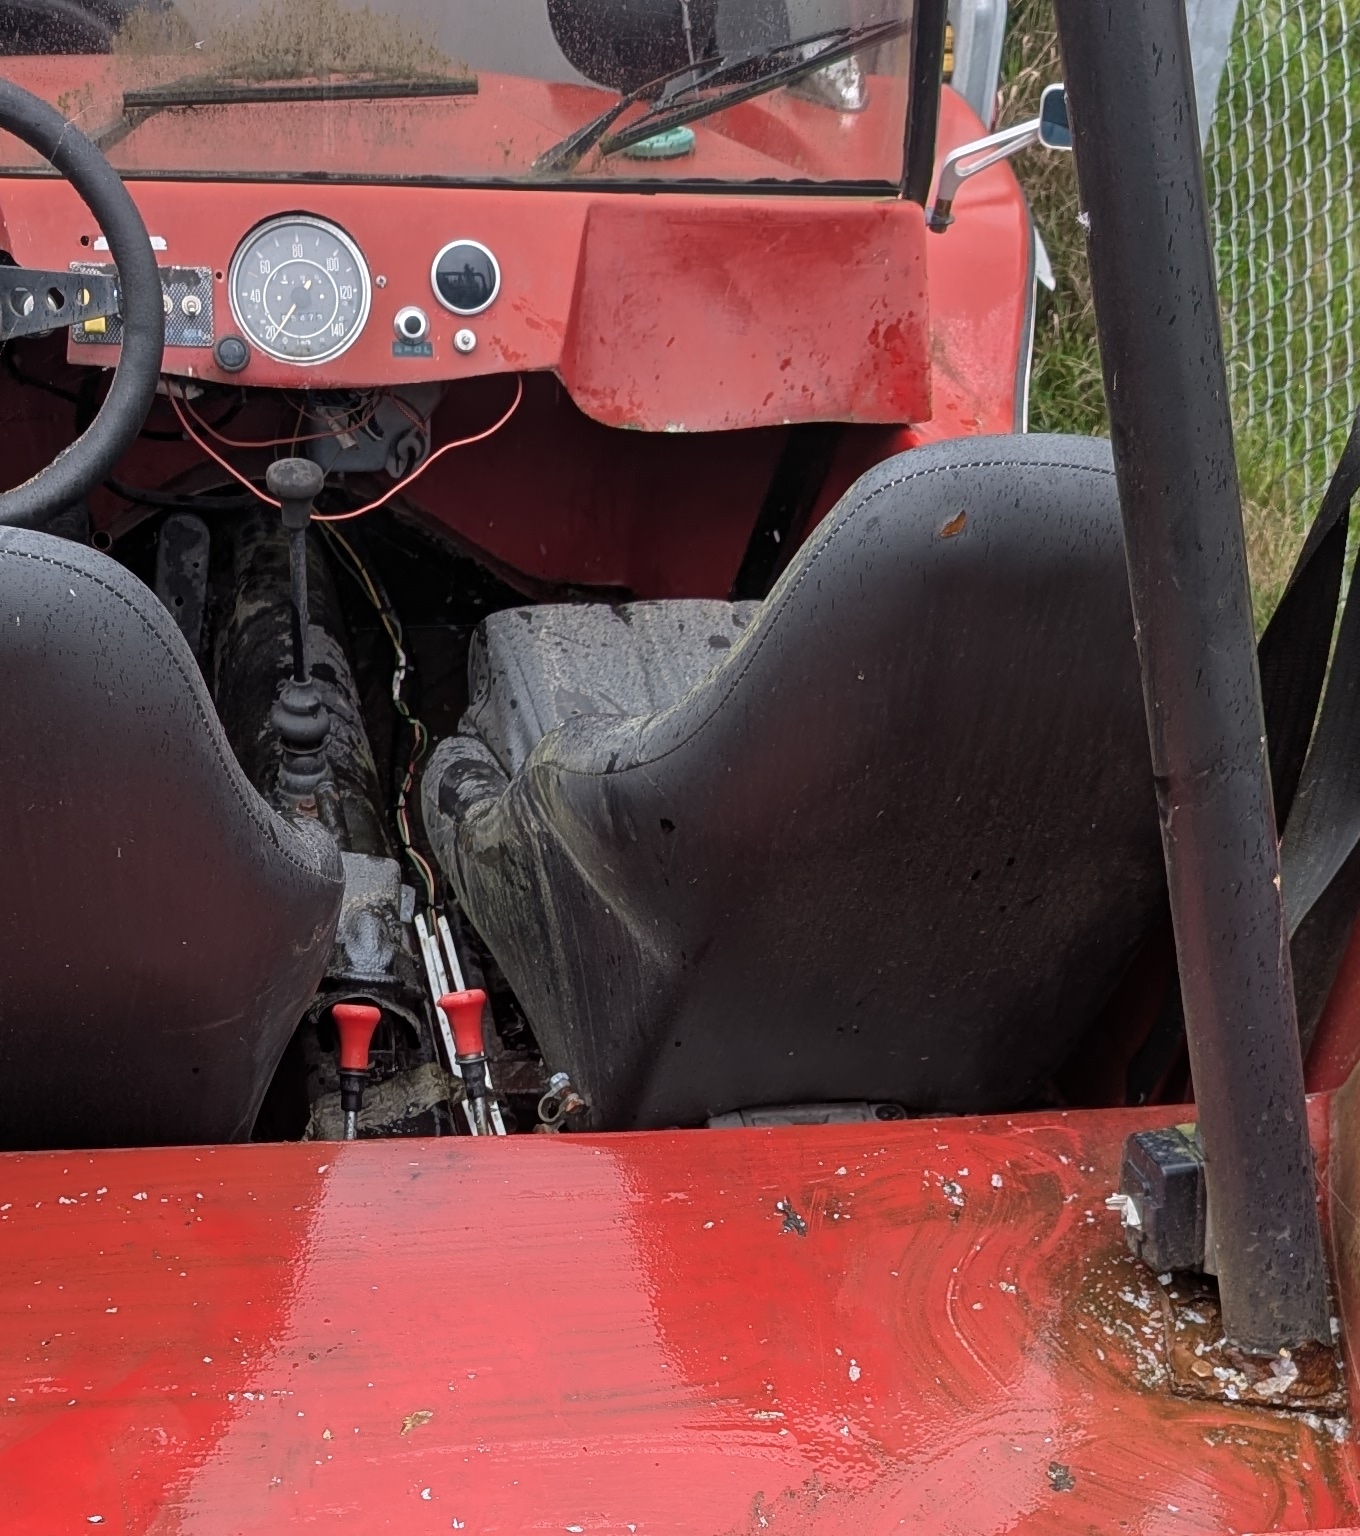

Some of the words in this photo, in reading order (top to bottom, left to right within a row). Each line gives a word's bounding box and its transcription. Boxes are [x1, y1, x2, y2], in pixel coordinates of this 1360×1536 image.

[292, 243, 304, 258] 80
[260, 259, 271, 274] 60
[326, 257, 339, 272] 100
[250, 288, 261, 303] 40
[339, 285, 353, 300] 120
[265, 325, 276, 340] 20
[330, 322, 344, 337] 140
